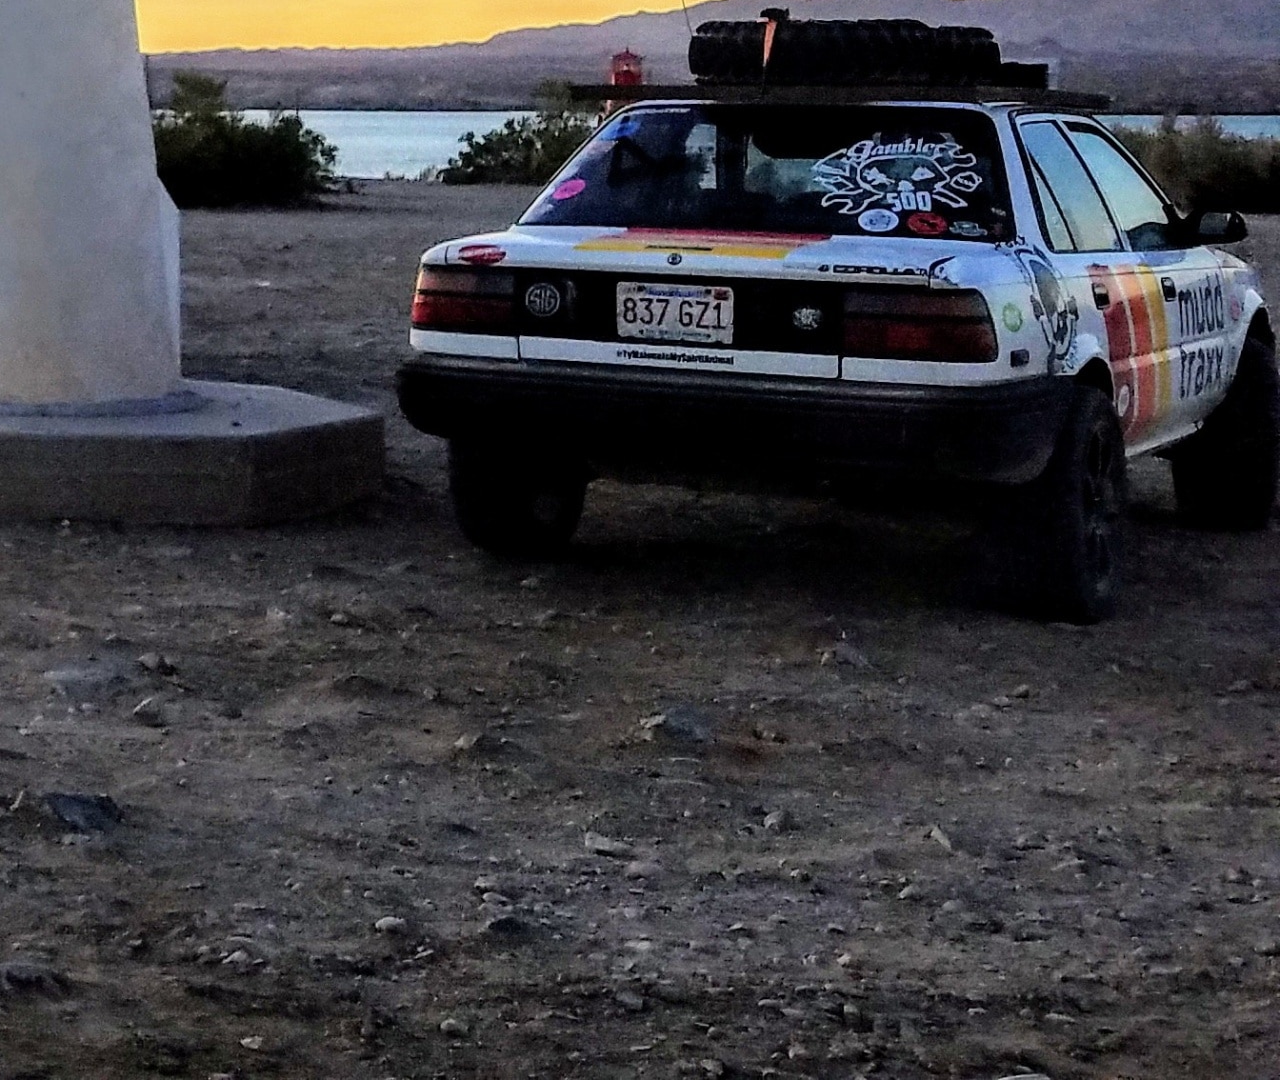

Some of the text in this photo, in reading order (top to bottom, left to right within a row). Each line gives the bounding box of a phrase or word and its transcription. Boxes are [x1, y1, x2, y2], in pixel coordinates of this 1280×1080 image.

[886, 191, 931, 212] 500
[622, 297, 726, 330] 837 GZ1
[1178, 273, 1224, 337] mudd
[1180, 344, 1224, 399] traxx
